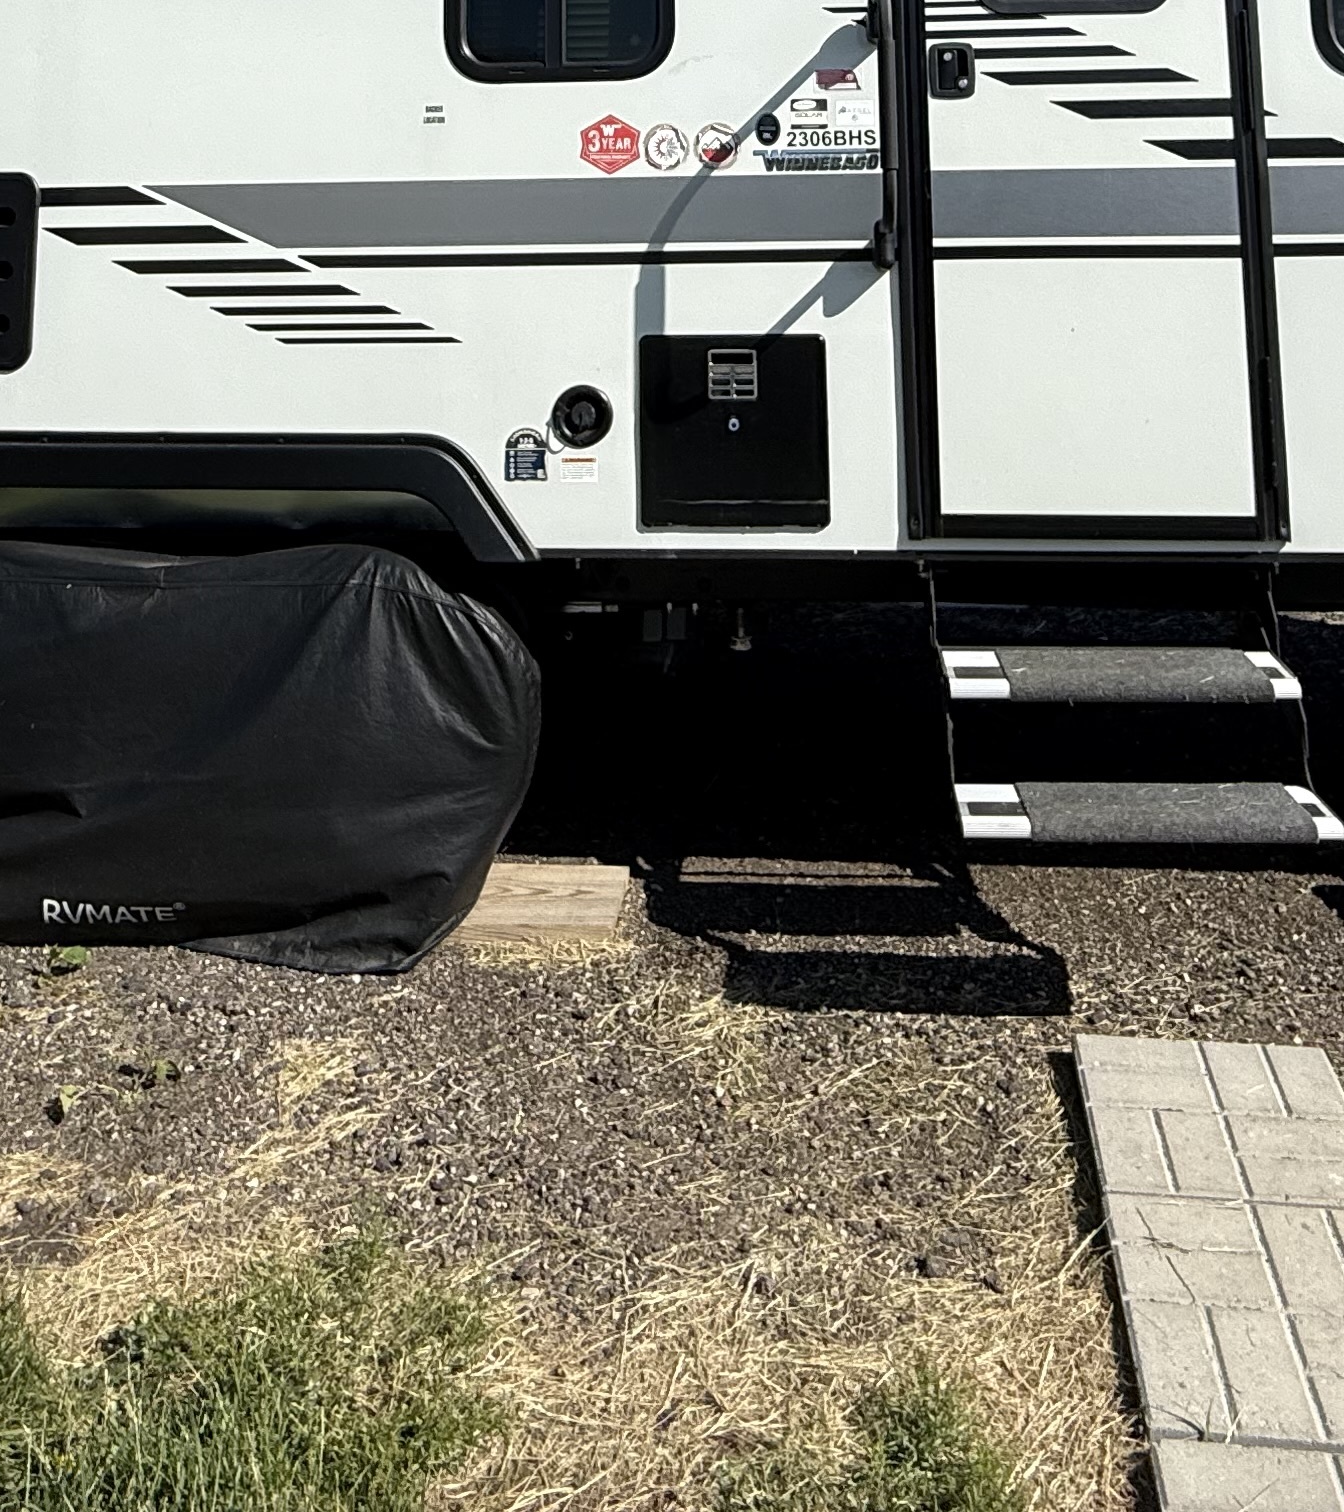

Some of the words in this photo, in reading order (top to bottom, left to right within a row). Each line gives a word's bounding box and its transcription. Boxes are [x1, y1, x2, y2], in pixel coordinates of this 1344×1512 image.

[587, 129, 601, 153] 3
[601, 137, 632, 150] YEAR
[786, 129, 877, 147] 2306BHS
[753, 148, 879, 172] WINNEBAGO
